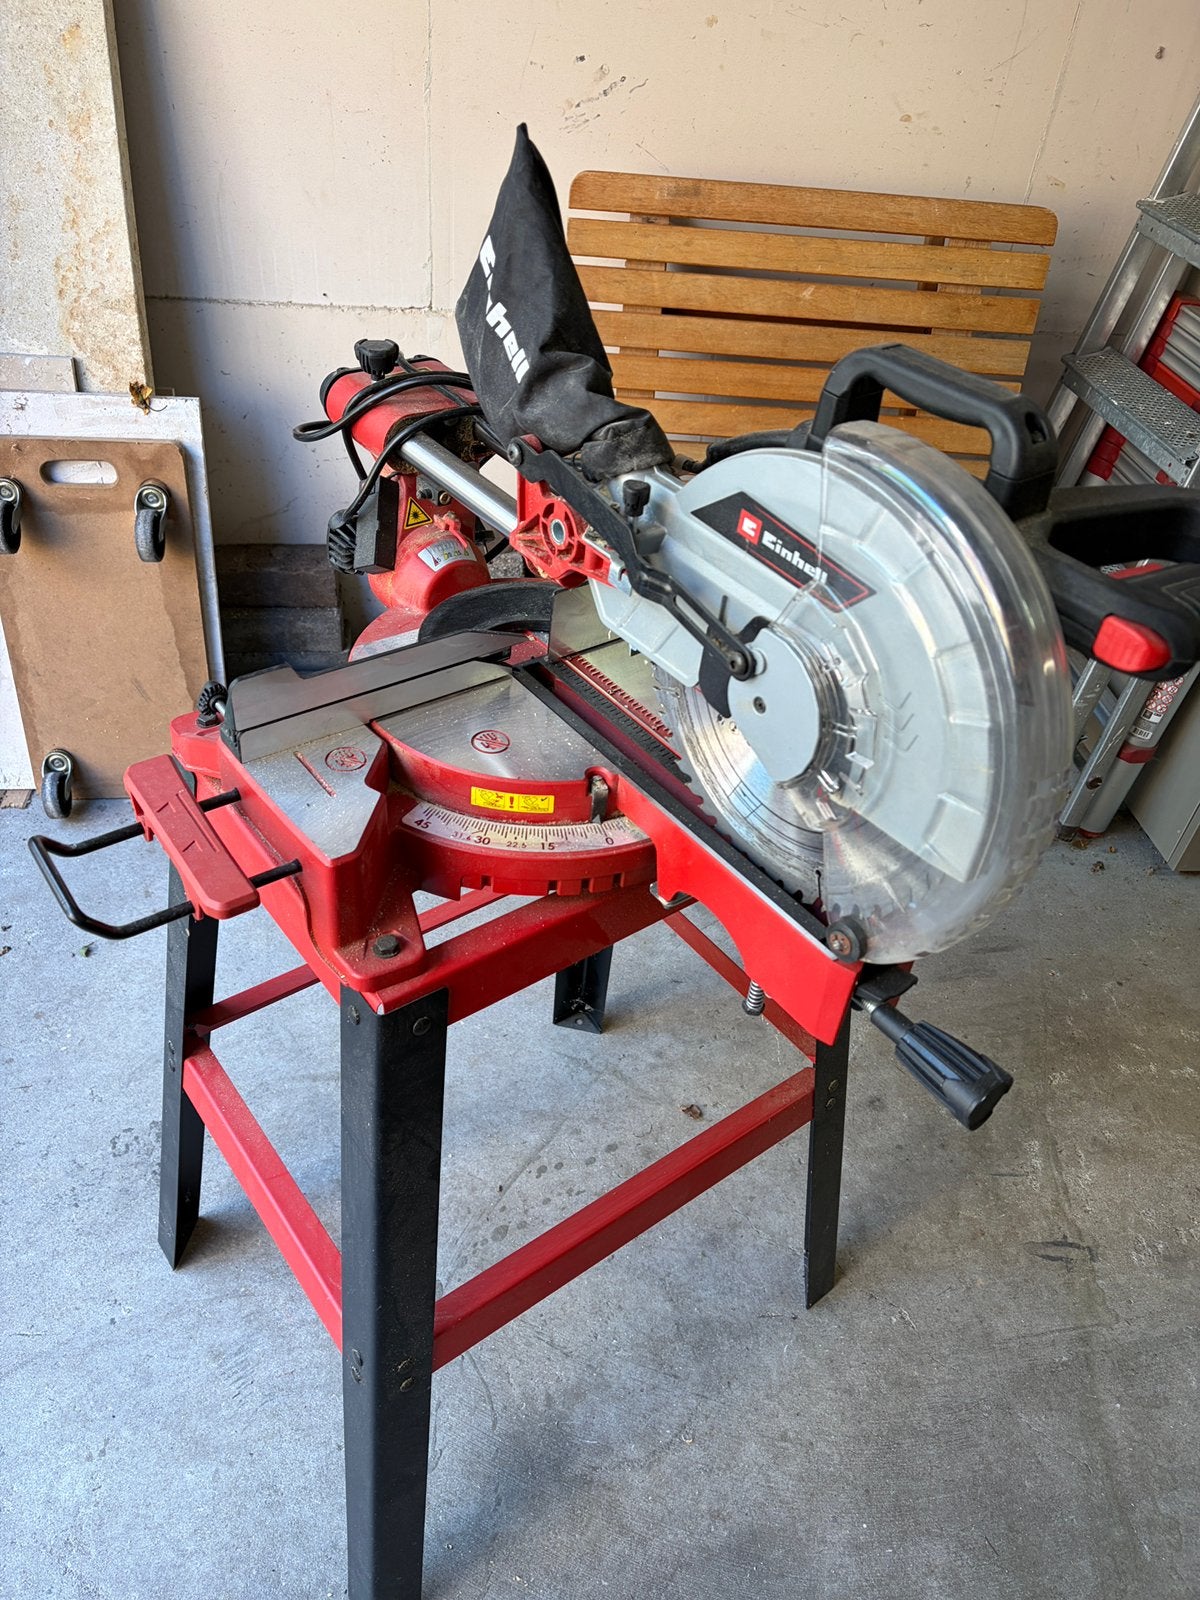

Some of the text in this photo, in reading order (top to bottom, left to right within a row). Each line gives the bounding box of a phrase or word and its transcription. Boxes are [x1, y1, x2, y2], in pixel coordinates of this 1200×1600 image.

[761, 530, 828, 586] Einhell
[414, 819, 431, 829] 45
[473, 836, 491, 845] 30
[506, 841, 527, 849] 22.5
[540, 842, 555, 850] 15
[605, 837, 614, 845] 0
